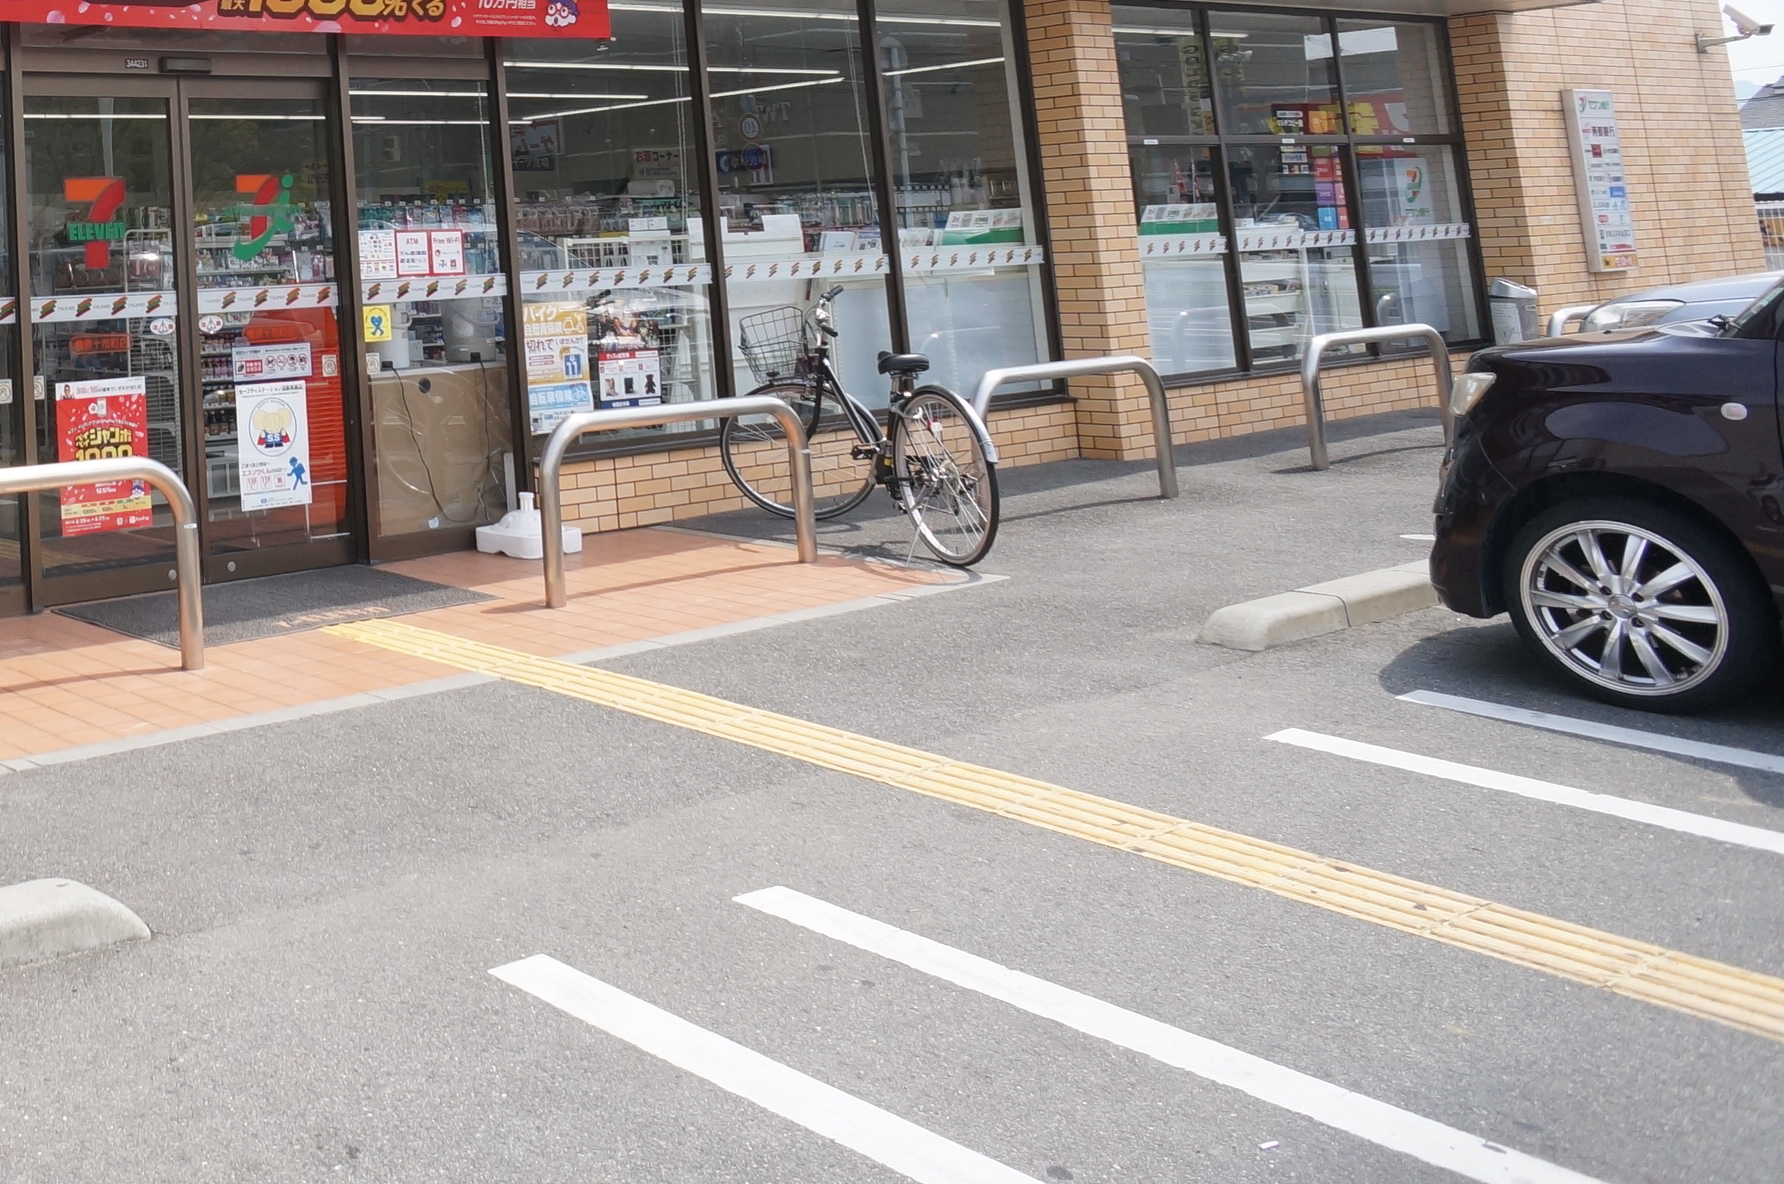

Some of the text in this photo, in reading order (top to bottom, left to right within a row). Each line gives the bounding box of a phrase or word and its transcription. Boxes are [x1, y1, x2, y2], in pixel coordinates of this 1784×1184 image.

[126, 59, 148, 68] 344231
[524, 305, 557, 322] バイク
[526, 339, 554, 352] 切れて
